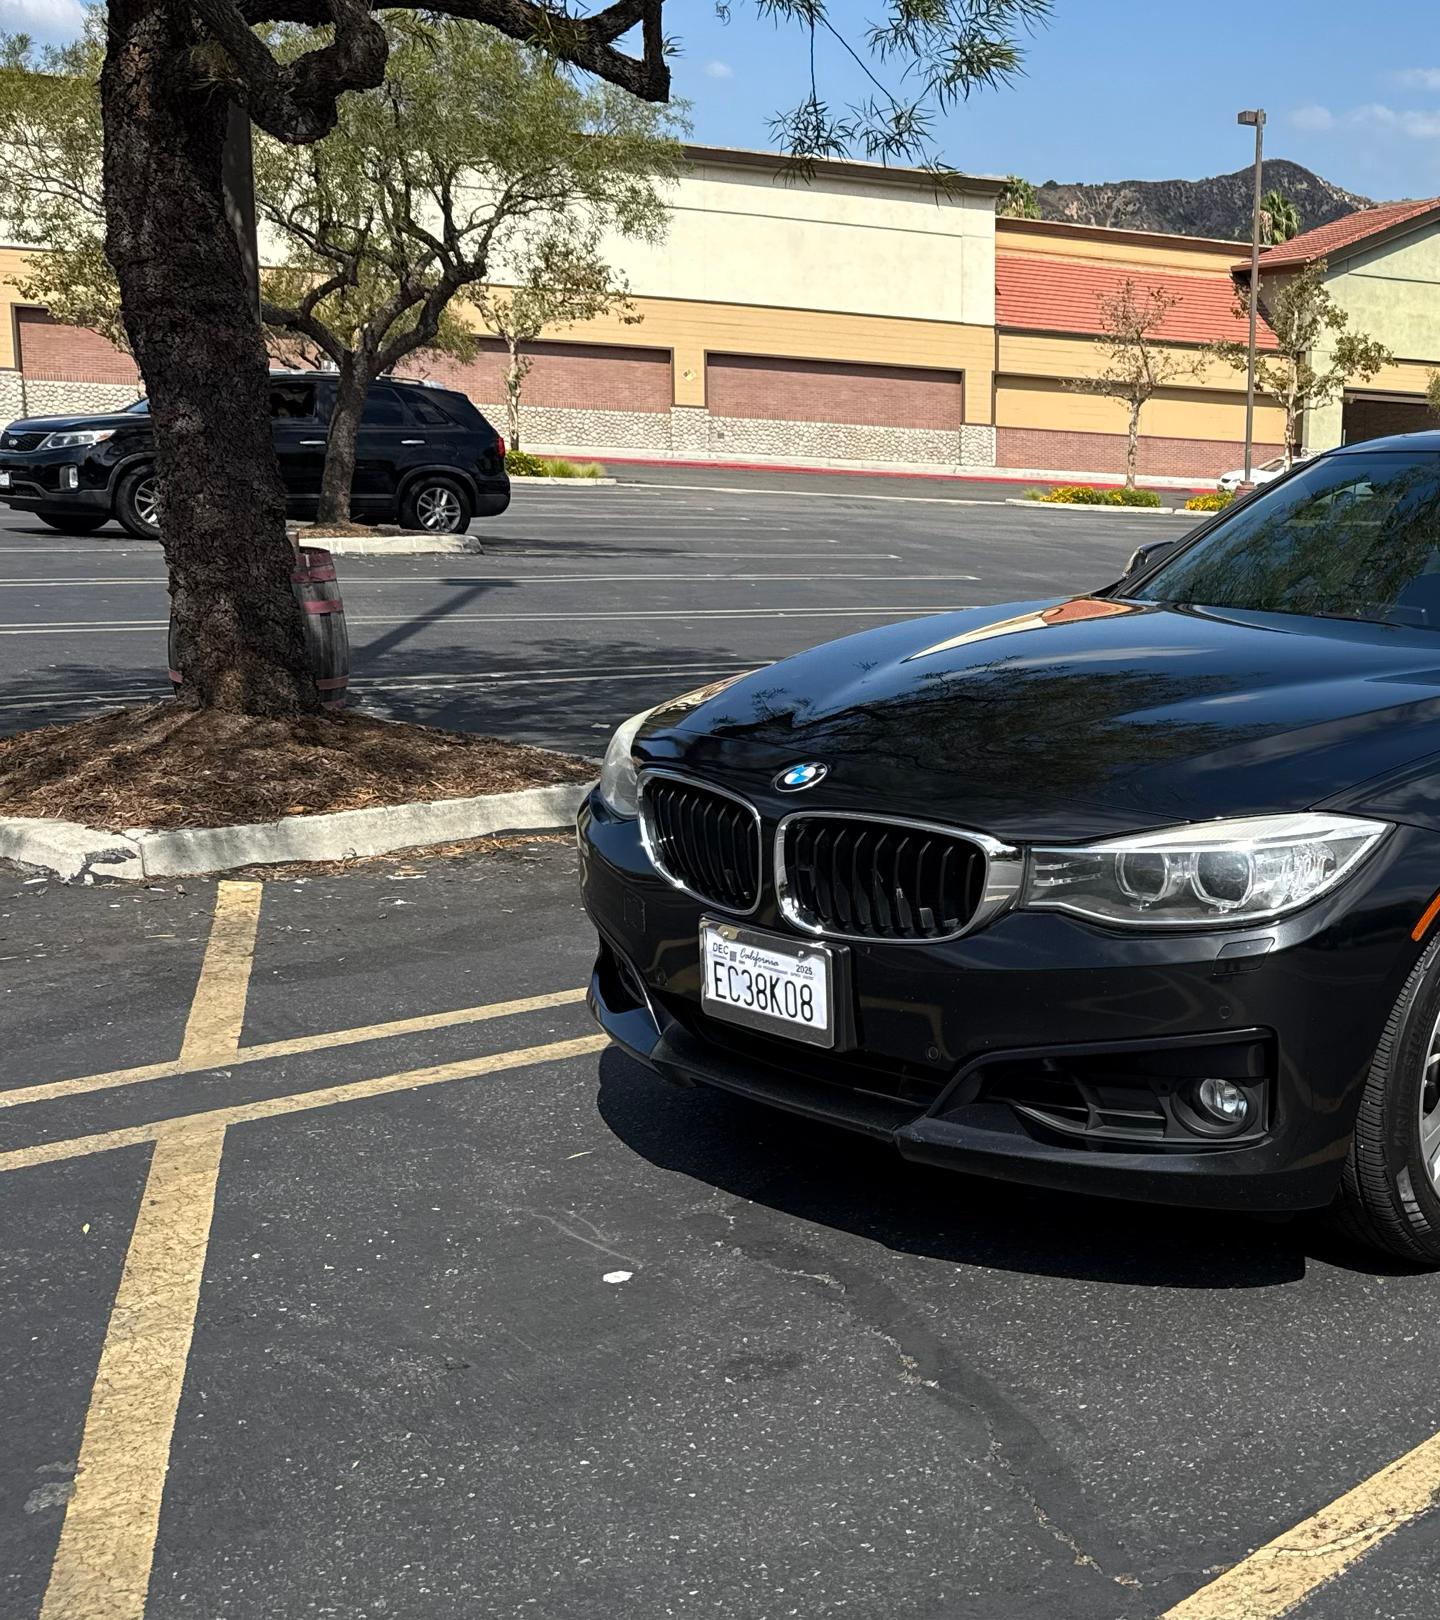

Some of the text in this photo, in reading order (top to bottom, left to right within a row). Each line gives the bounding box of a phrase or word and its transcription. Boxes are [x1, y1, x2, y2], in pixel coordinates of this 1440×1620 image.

[713, 942, 729, 955] DEC
[740, 947, 780, 967] California
[795, 964, 813, 975] 2025
[714, 961, 813, 1022] EC38K08
